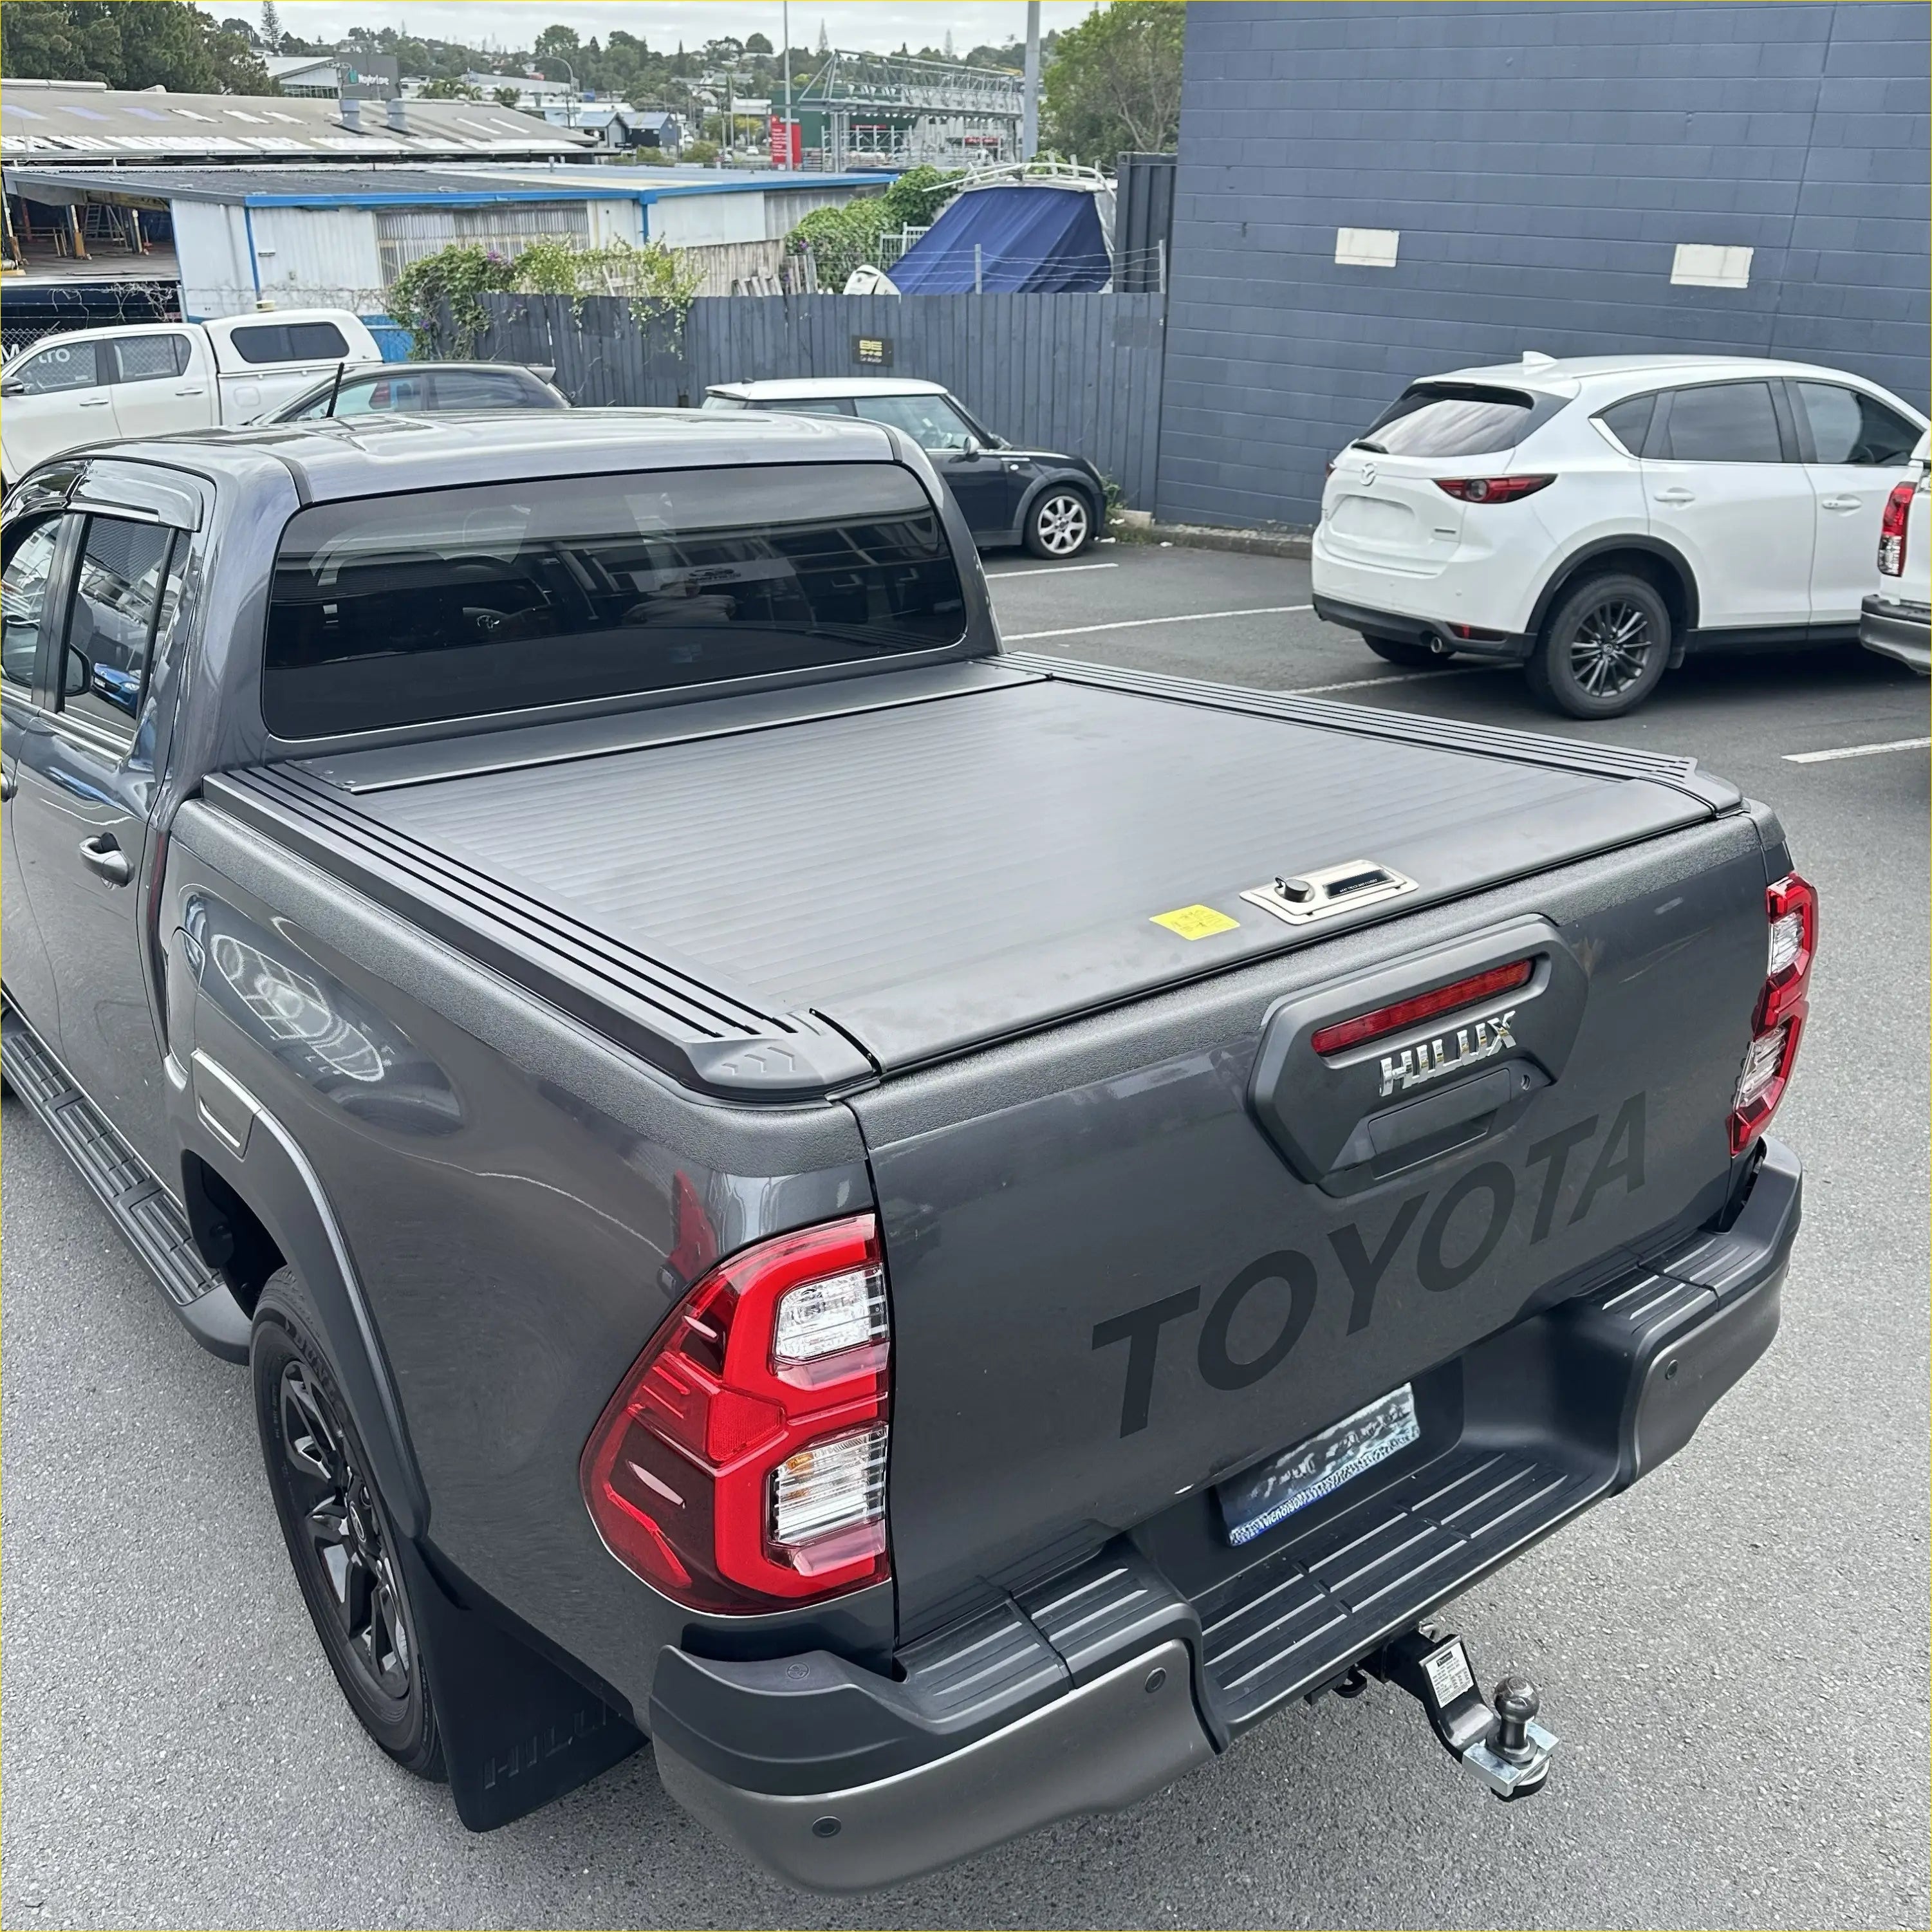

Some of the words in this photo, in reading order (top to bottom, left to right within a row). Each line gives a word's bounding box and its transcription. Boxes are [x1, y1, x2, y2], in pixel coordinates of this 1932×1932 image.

[1380, 1010, 1516, 1096] HILUX
[1092, 1091, 1646, 1438] TOYOTA
[484, 1699, 620, 1789] HILU
